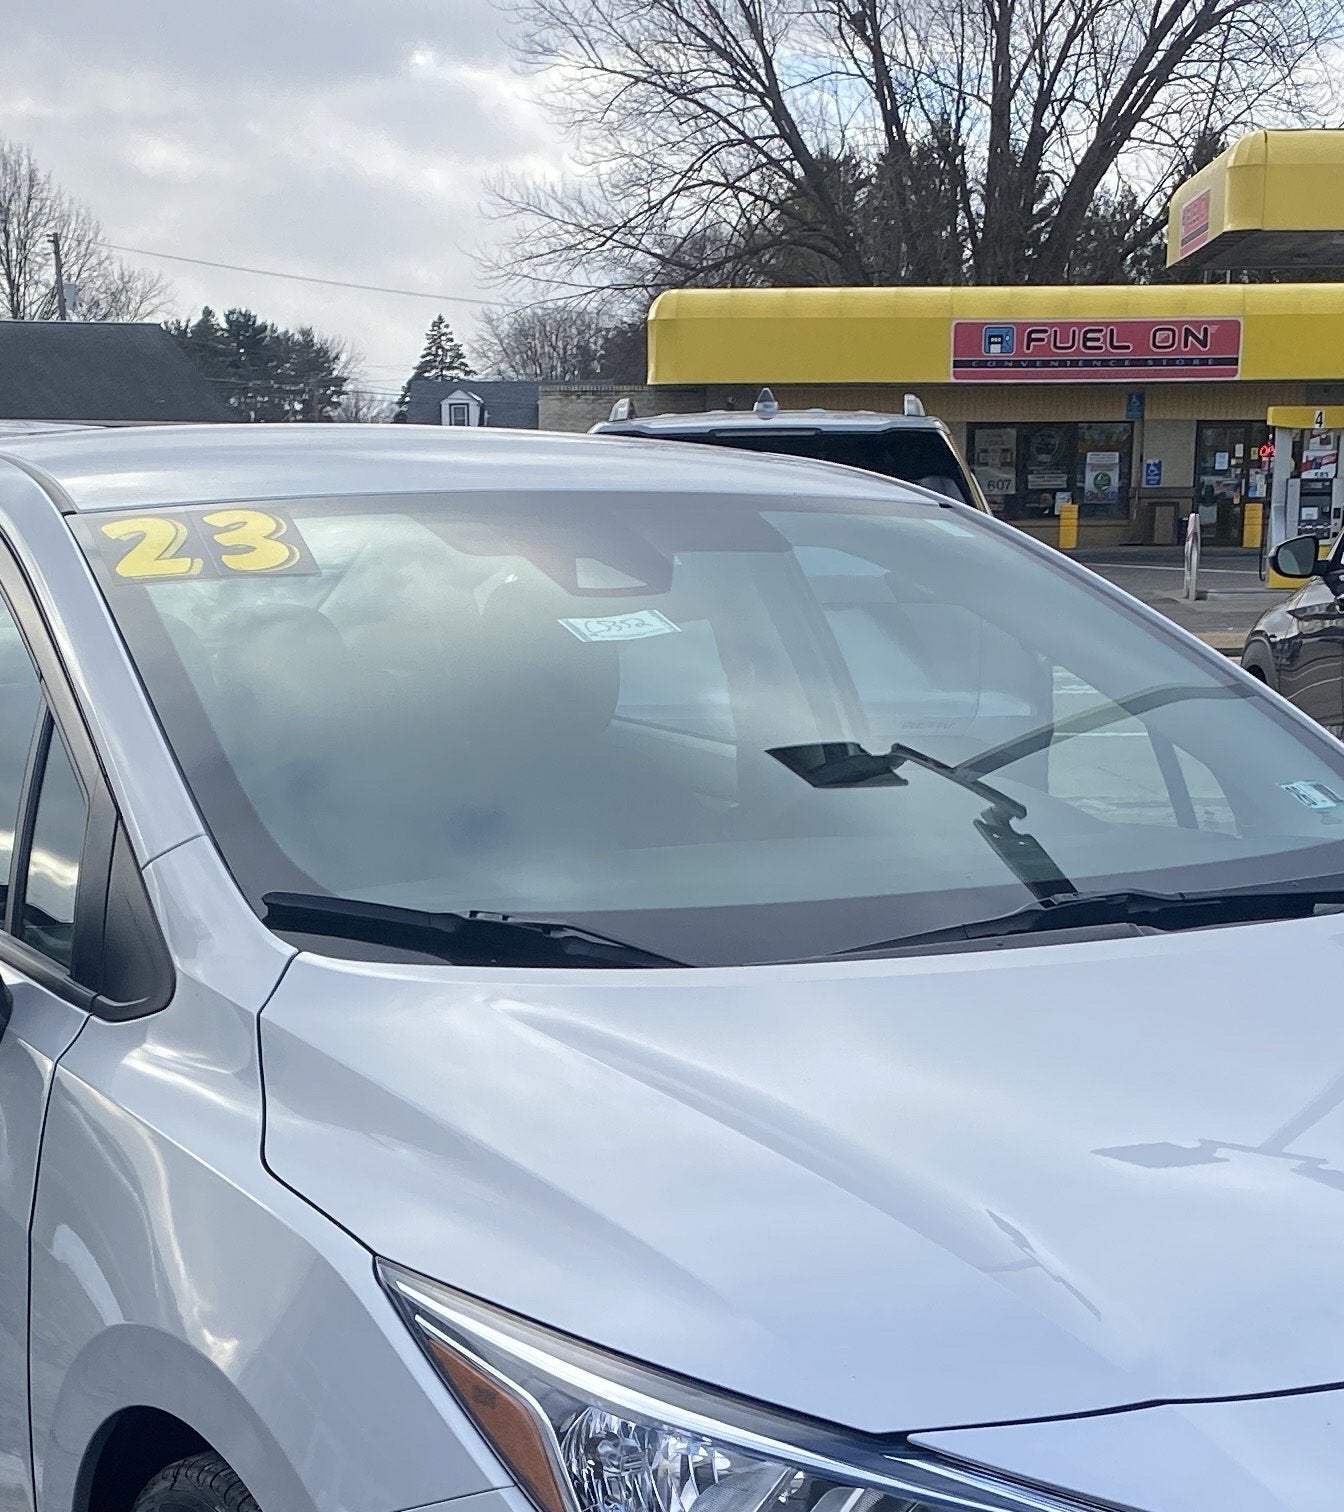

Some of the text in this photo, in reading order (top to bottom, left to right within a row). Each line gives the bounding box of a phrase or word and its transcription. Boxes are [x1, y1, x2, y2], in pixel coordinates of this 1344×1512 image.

[1024, 325, 1212, 353] FUEL ON
[971, 358, 1216, 368] CONVENIENCE STORE
[1315, 411, 1324, 428] 4
[987, 479, 1012, 491] 607
[100, 508, 301, 579] 23
